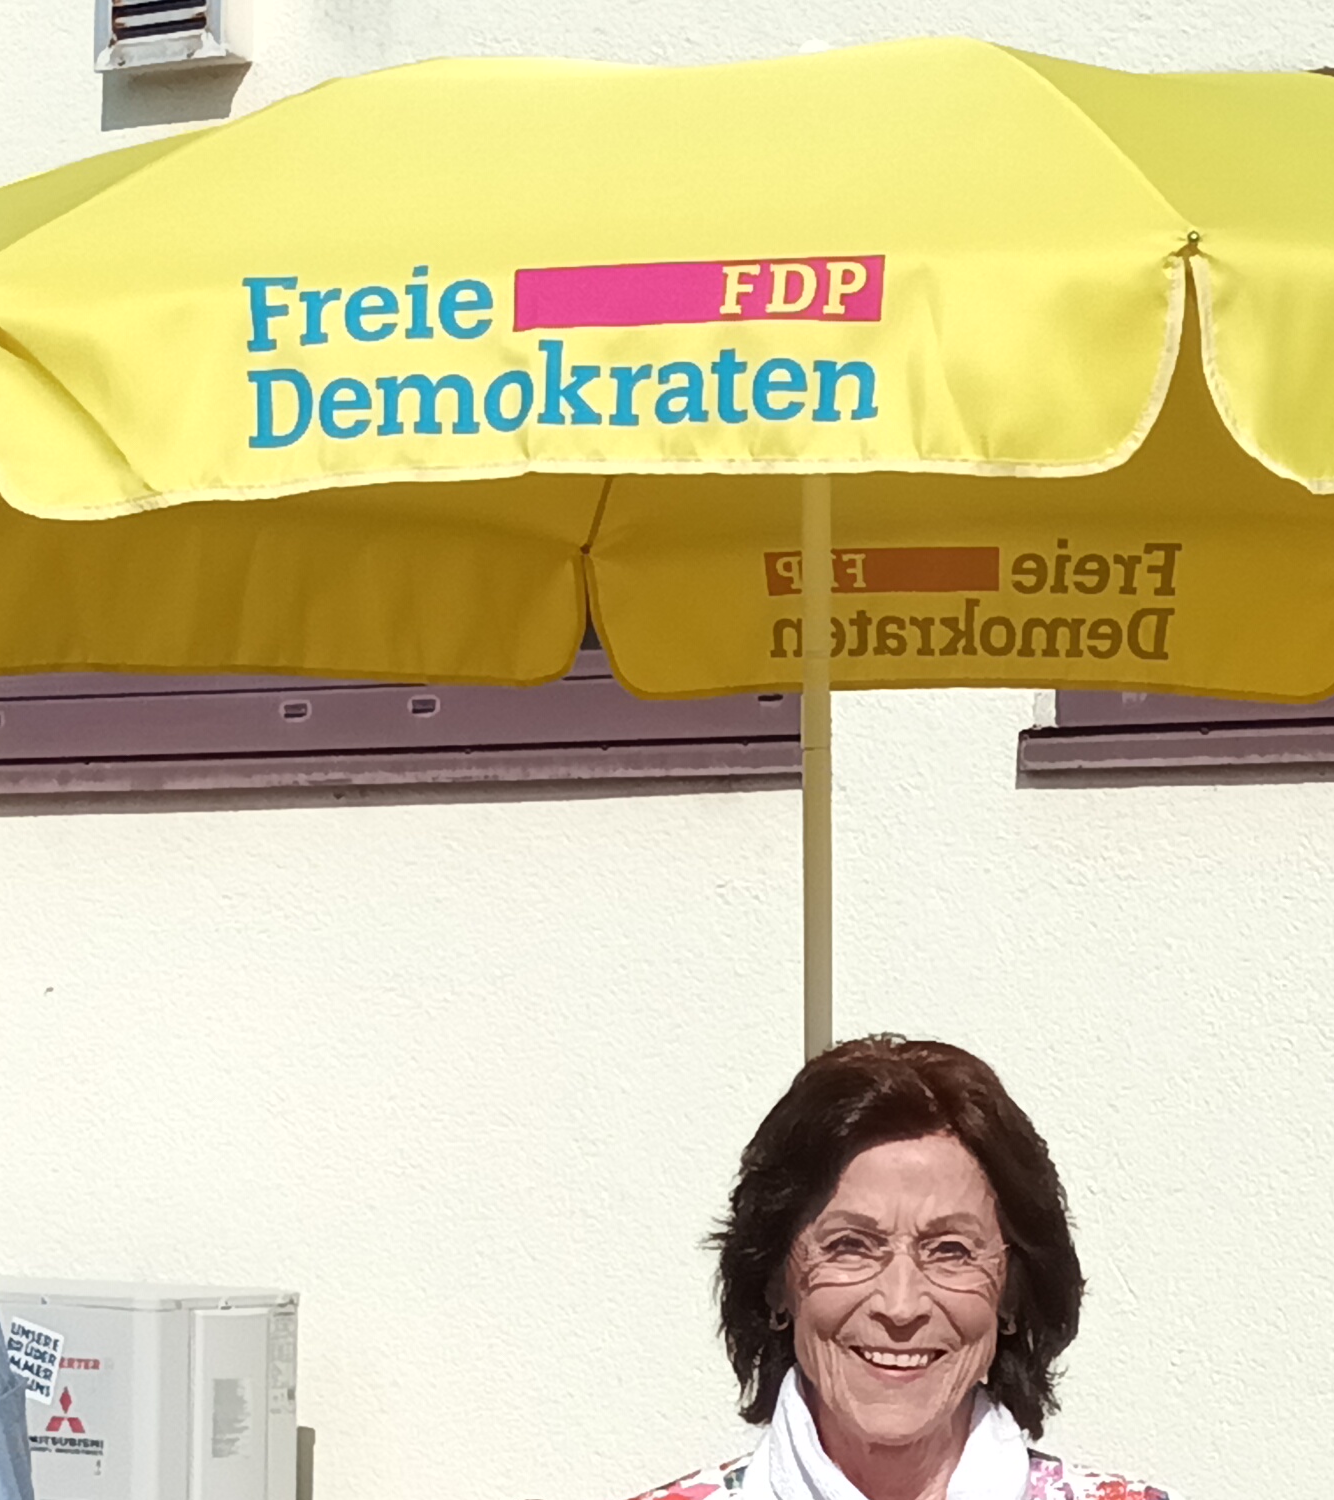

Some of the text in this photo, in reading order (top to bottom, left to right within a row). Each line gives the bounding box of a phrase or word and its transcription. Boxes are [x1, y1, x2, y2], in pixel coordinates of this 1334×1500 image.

[243, 261, 867, 352] Freie FDP
[247, 340, 879, 449] Demokraten
